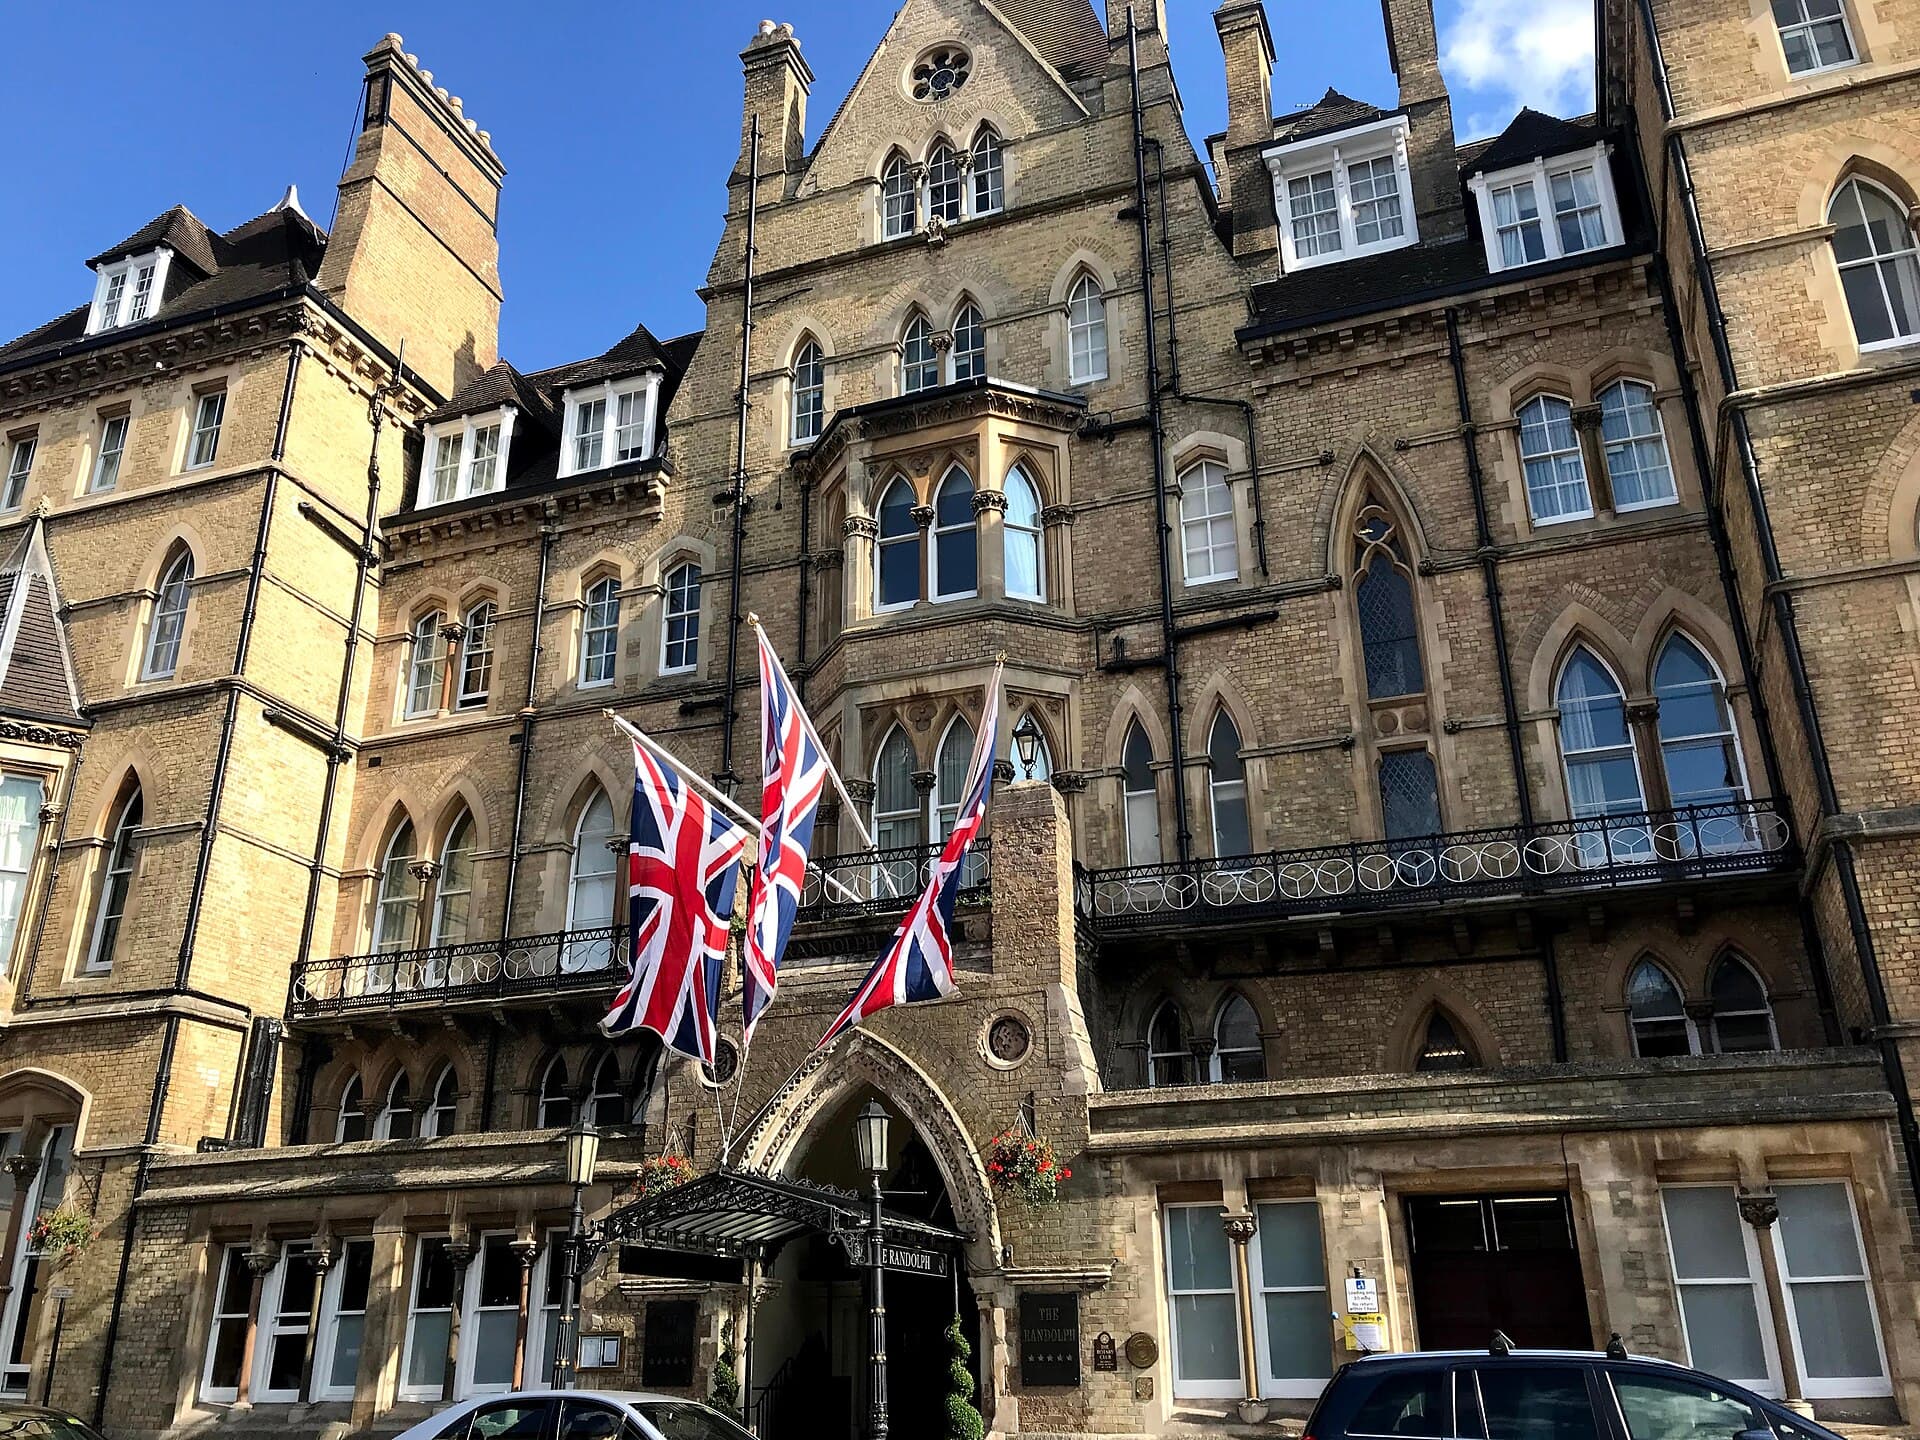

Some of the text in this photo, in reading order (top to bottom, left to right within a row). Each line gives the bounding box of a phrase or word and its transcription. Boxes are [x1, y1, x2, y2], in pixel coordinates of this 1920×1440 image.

[889, 1249, 931, 1270] RANDOLPH
[1039, 1307, 1060, 1321] THE
[1024, 1328, 1076, 1343] RANDOLPH
